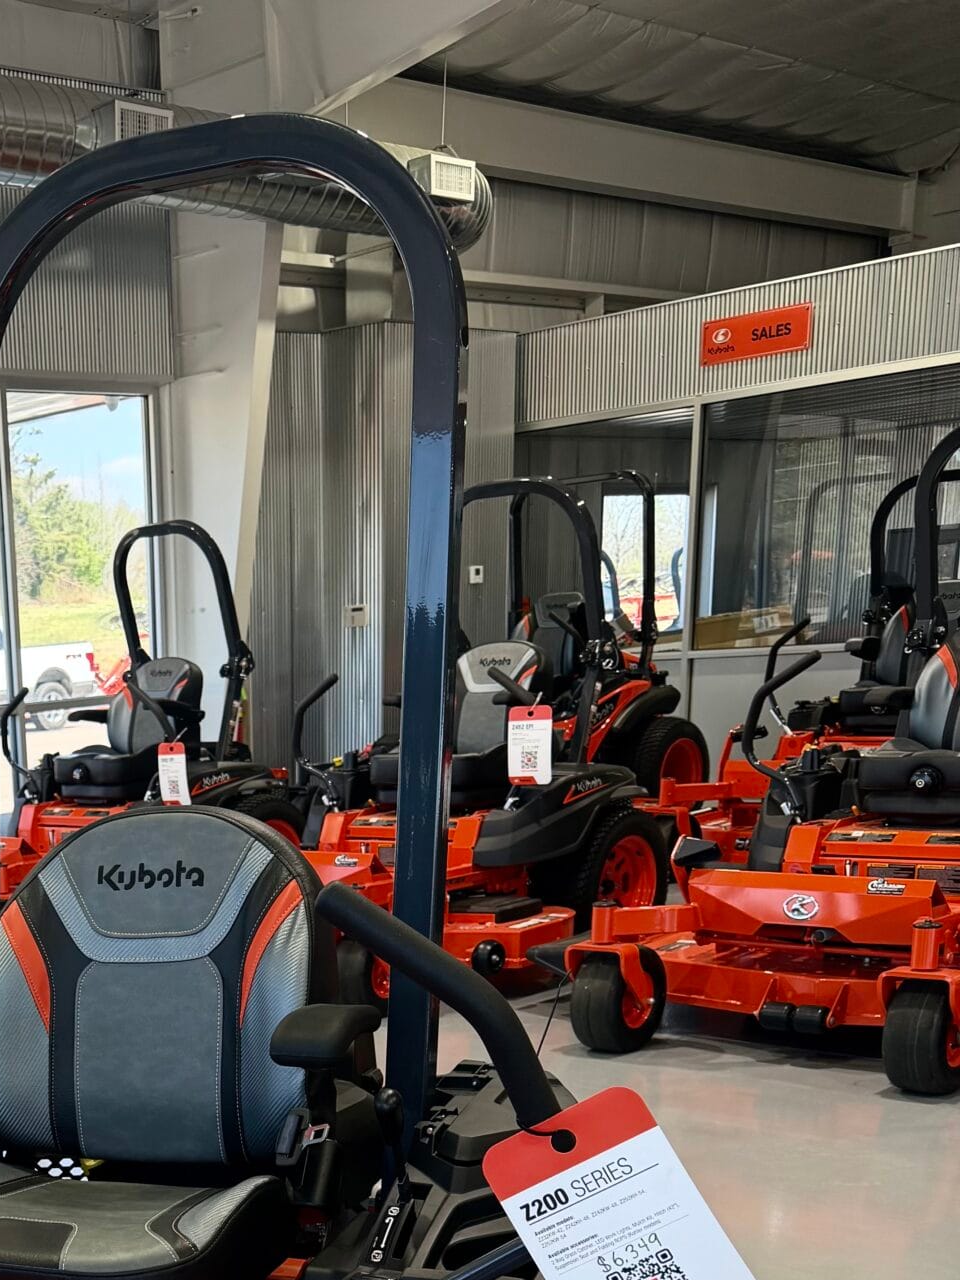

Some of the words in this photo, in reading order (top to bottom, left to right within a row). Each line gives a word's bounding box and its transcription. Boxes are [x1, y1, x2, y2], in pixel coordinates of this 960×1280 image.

[751, 322, 792, 341] SALES
[708, 345, 735, 355] Kubota
[479, 656, 511, 667] Kubota
[97, 860, 205, 891] Kubota
[520, 1188, 569, 1222] Z200
[570, 1157, 633, 1197] SERIES
[534, 1223, 555, 1236] Available
[547, 1245, 569, 1259] Available
